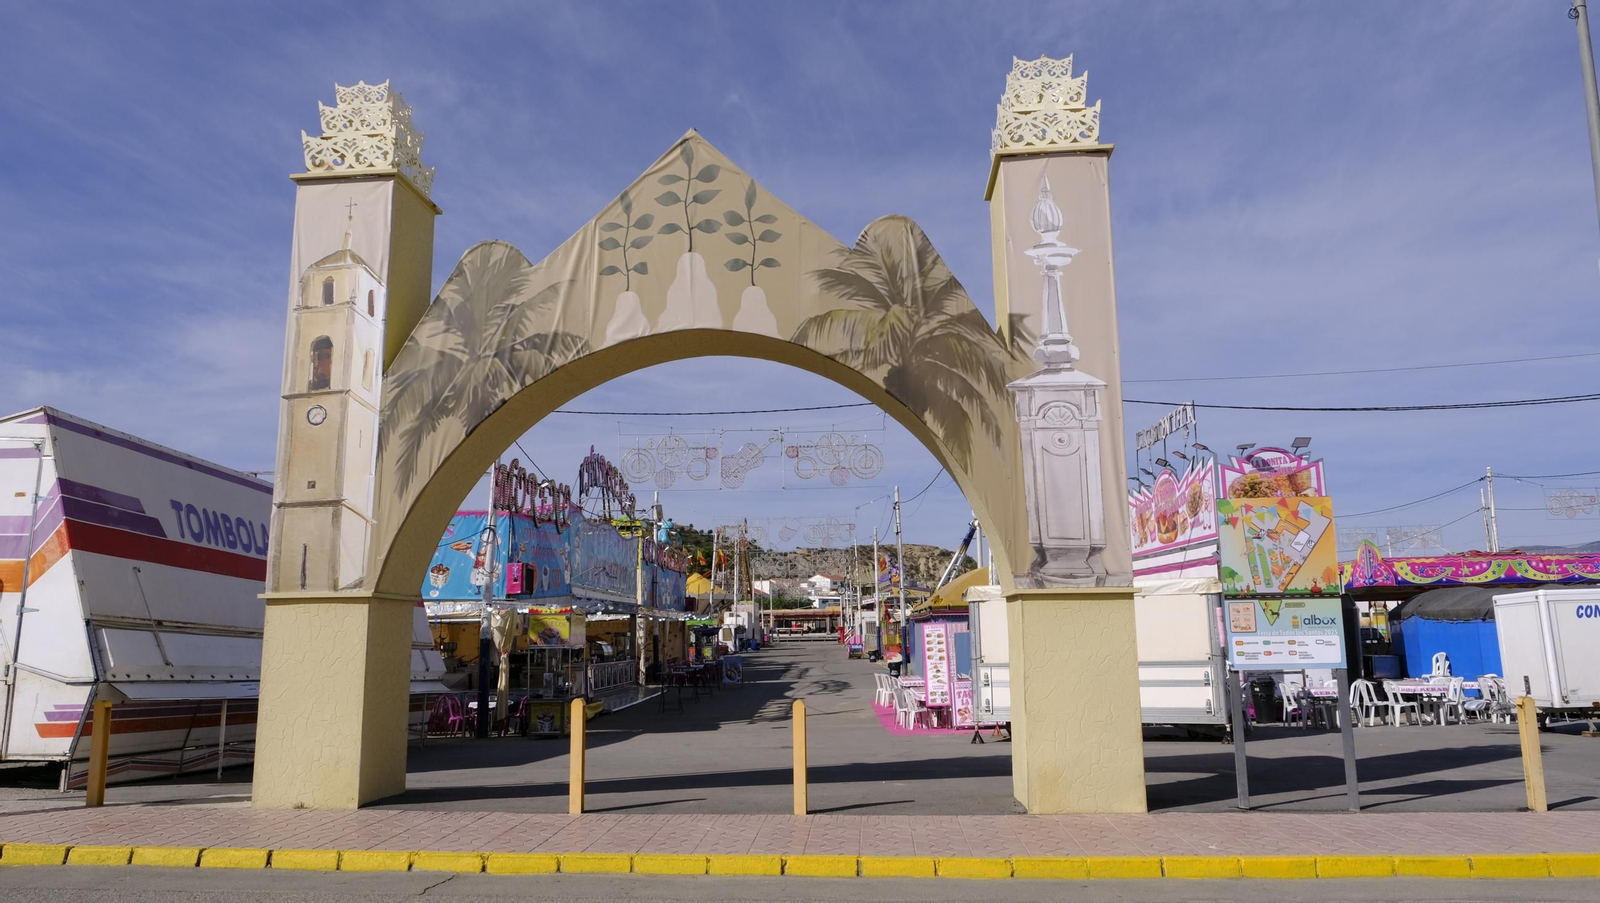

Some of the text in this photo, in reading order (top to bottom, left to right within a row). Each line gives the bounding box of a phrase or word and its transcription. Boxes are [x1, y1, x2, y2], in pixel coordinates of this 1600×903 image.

[1251, 456, 1288, 468] LA BONITA
[1576, 604, 1600, 619] CON
[1303, 614, 1336, 626] albox
